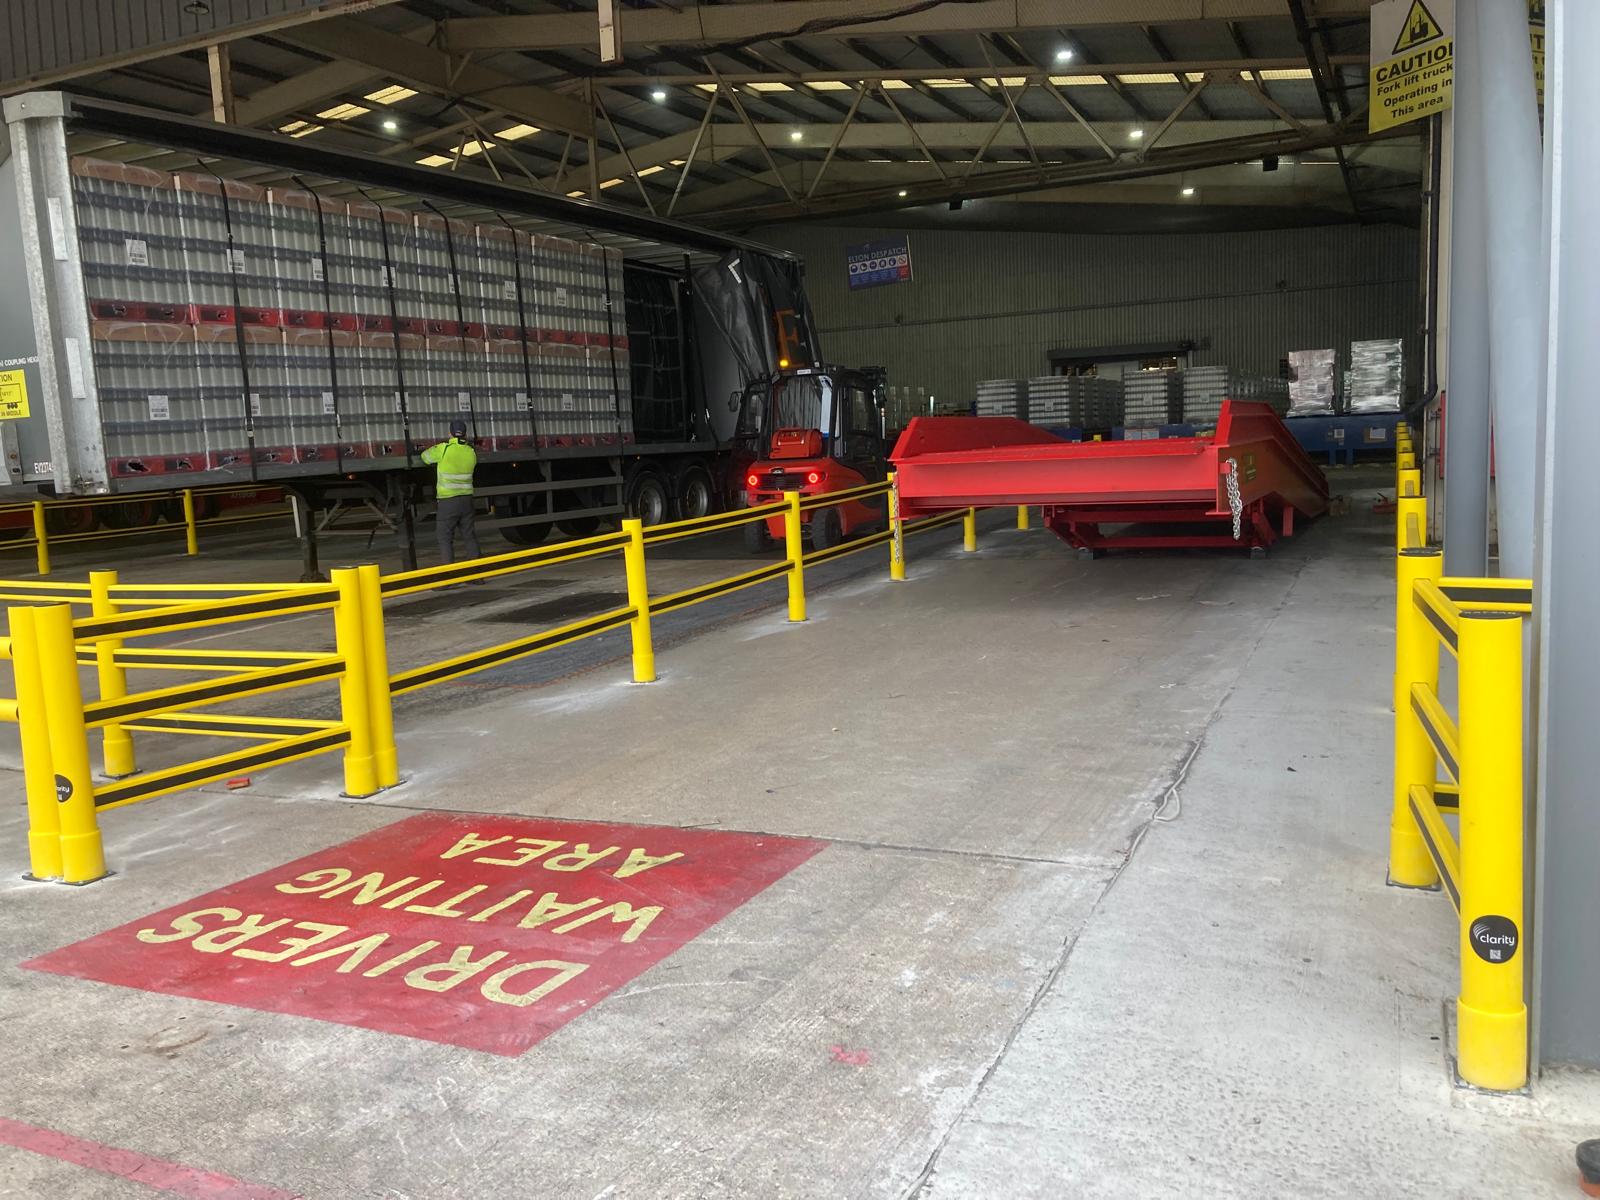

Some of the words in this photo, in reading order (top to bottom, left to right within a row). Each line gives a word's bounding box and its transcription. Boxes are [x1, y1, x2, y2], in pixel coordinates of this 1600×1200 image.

[1377, 82, 1400, 96] Fork
[1404, 74, 1419, 87] lift
[1384, 83, 1438, 107] Operating
[1442, 79, 1453, 87] in
[1391, 105, 1414, 119] This
[1417, 96, 1443, 110] area
[5, 358, 26, 366] COUPLING
[440, 832, 685, 879] AREA
[274, 867, 664, 943] WAITING
[1480, 933, 1515, 946] clarity
[136, 907, 591, 1007] DRIVERS
